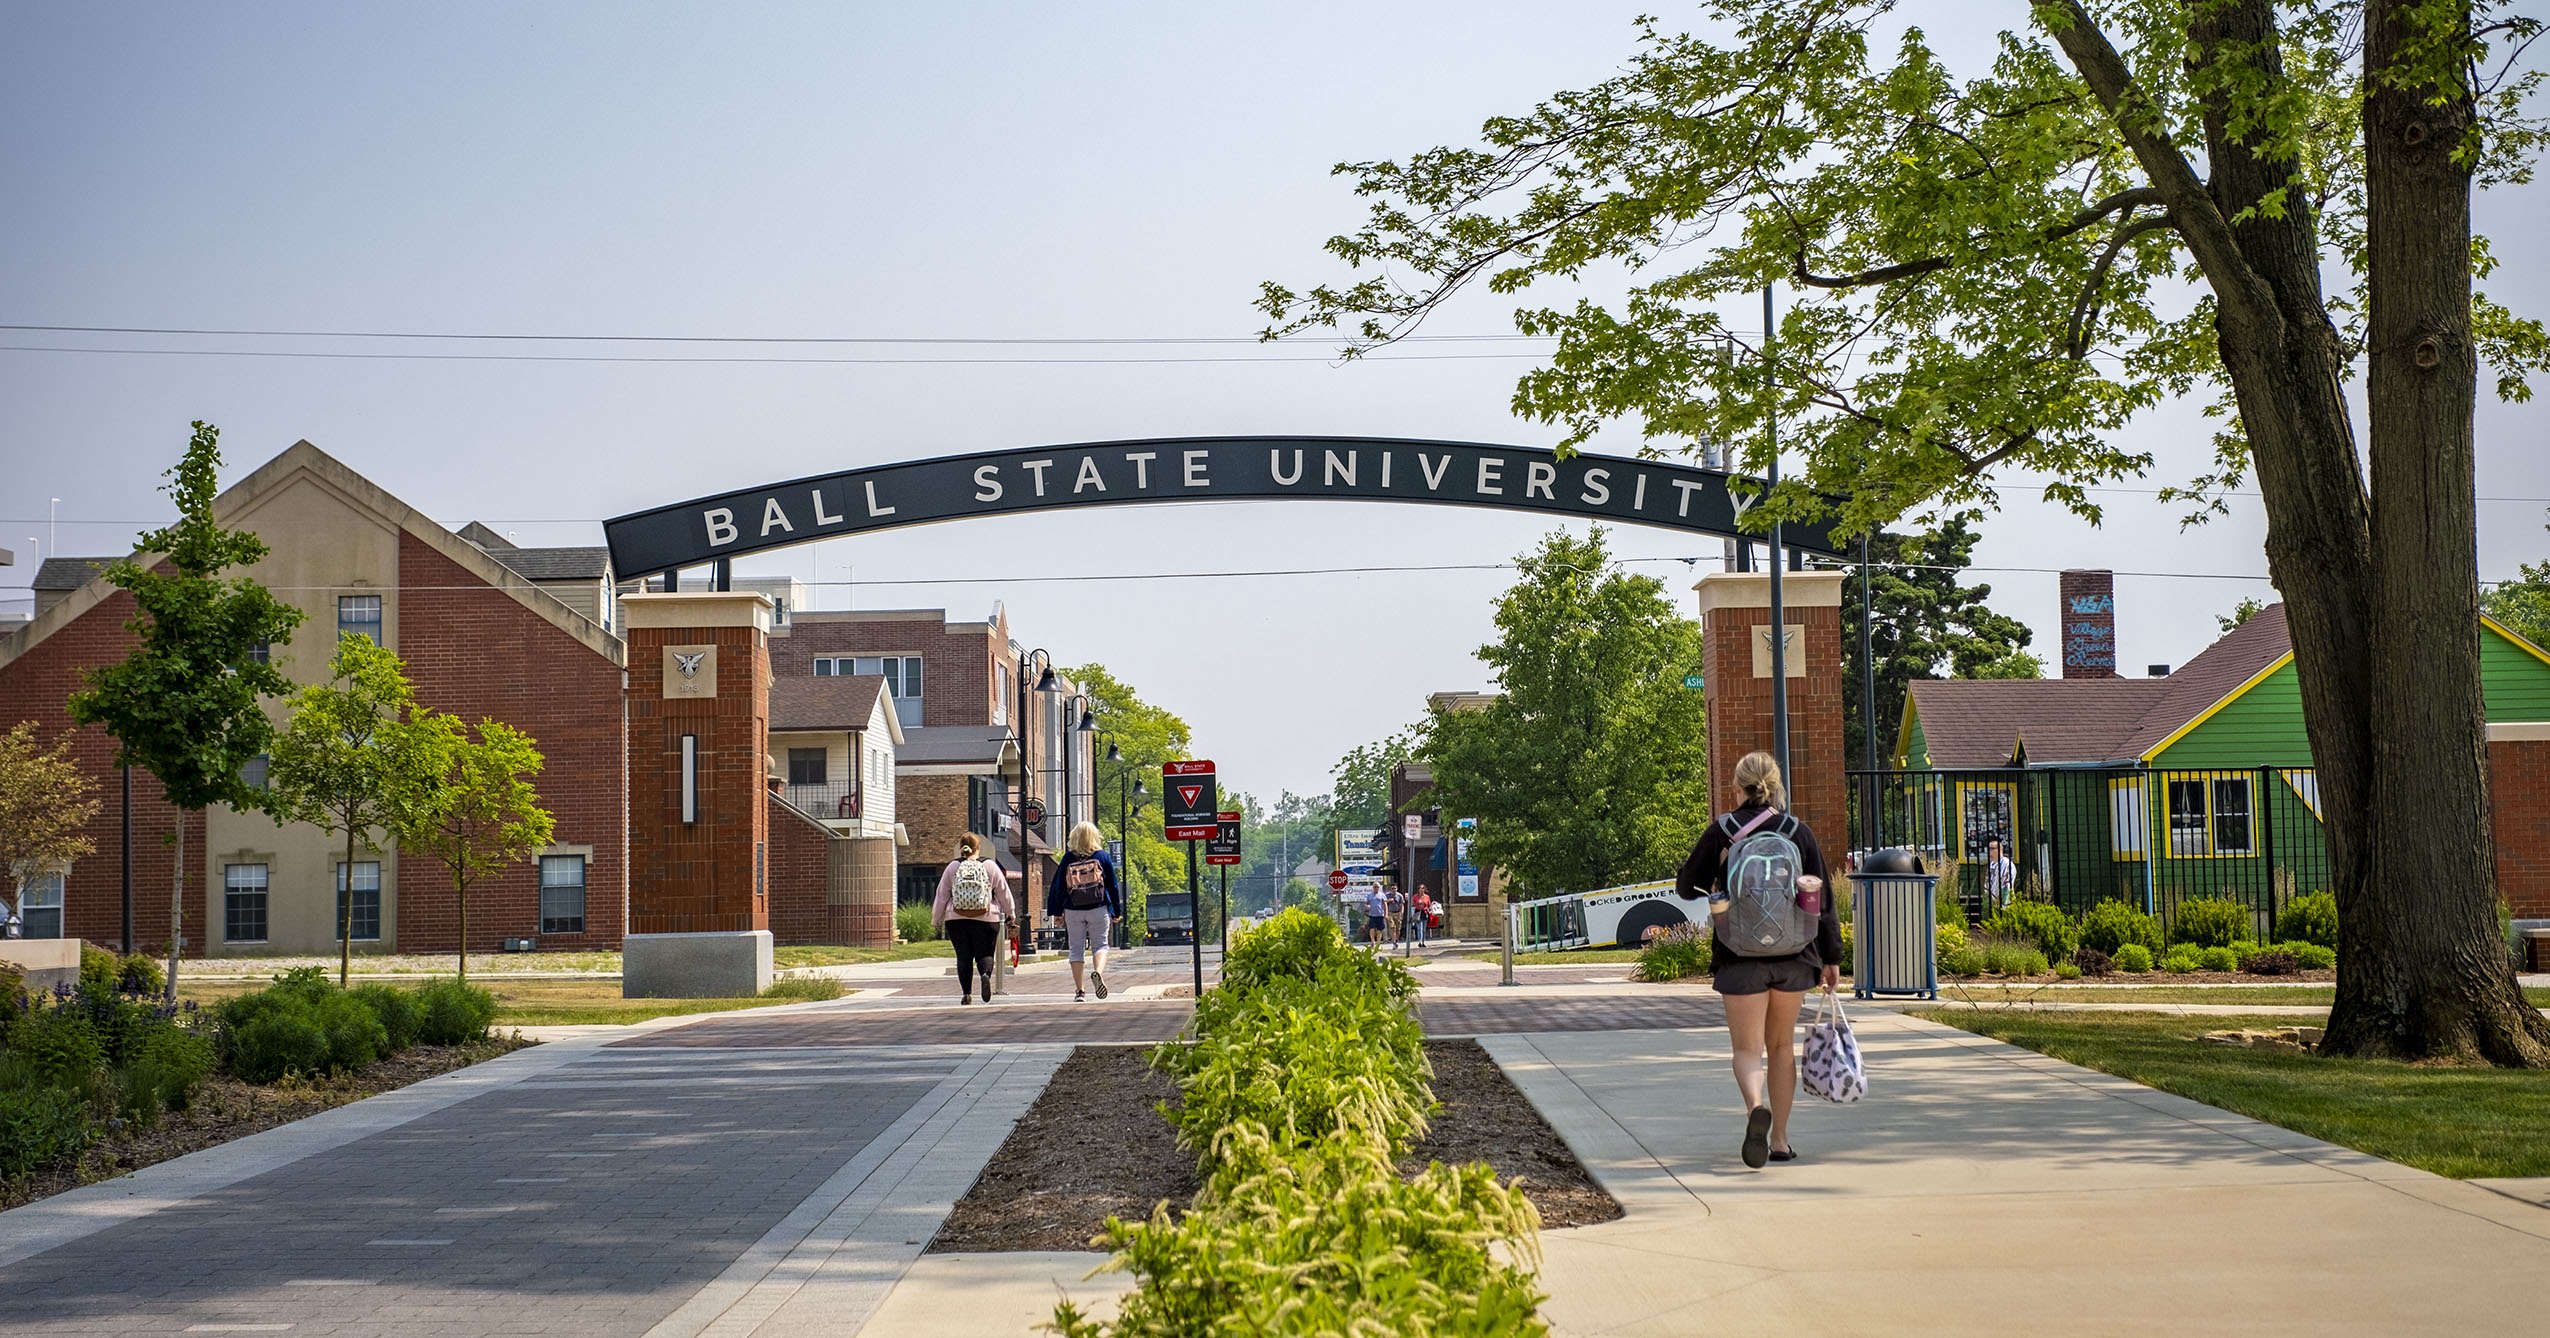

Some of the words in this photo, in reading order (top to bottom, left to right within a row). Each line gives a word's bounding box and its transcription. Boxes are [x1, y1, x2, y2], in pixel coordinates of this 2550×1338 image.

[703, 481, 896, 547] BALL
[973, 449, 1210, 502] STATE
[1271, 449, 1760, 526] UNIVERSITY
[2067, 621, 2113, 639] Village
[1329, 876, 1347, 884] STOP
[1584, 897, 1623, 908] LOCKED
[1623, 890, 1667, 902] GROOVE
